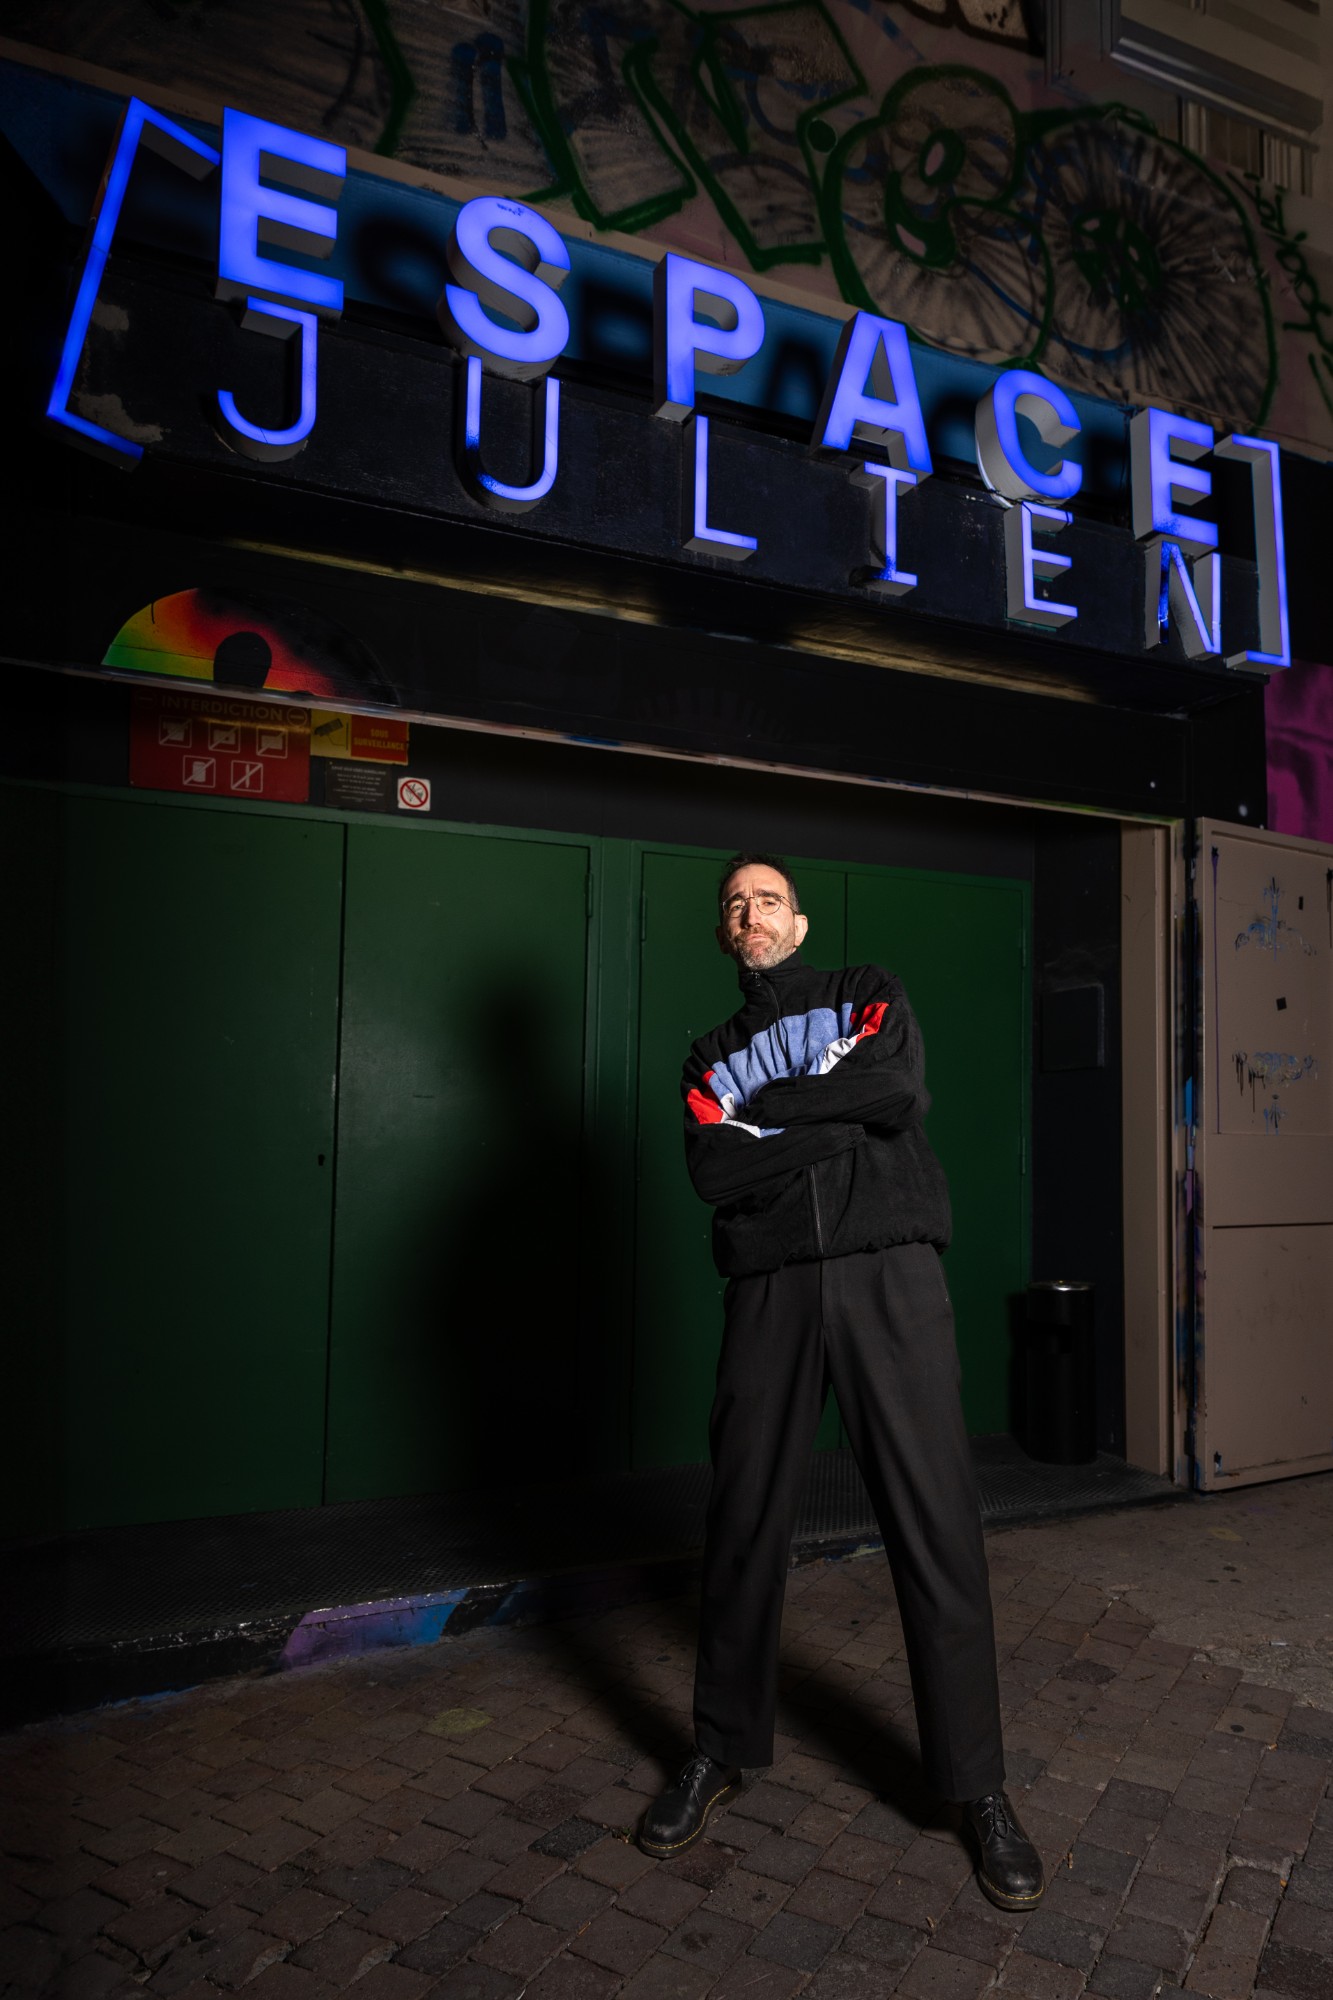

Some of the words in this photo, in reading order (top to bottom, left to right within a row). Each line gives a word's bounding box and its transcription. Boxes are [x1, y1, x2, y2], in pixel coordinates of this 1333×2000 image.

[215, 105, 1220, 548] ESPACE
[208, 295, 1223, 656] JULIEN
[161, 693, 283, 720] INTERDICTION
[353, 736, 405, 751] SURVEILLANCE
[370, 728, 389, 739] SOUS
